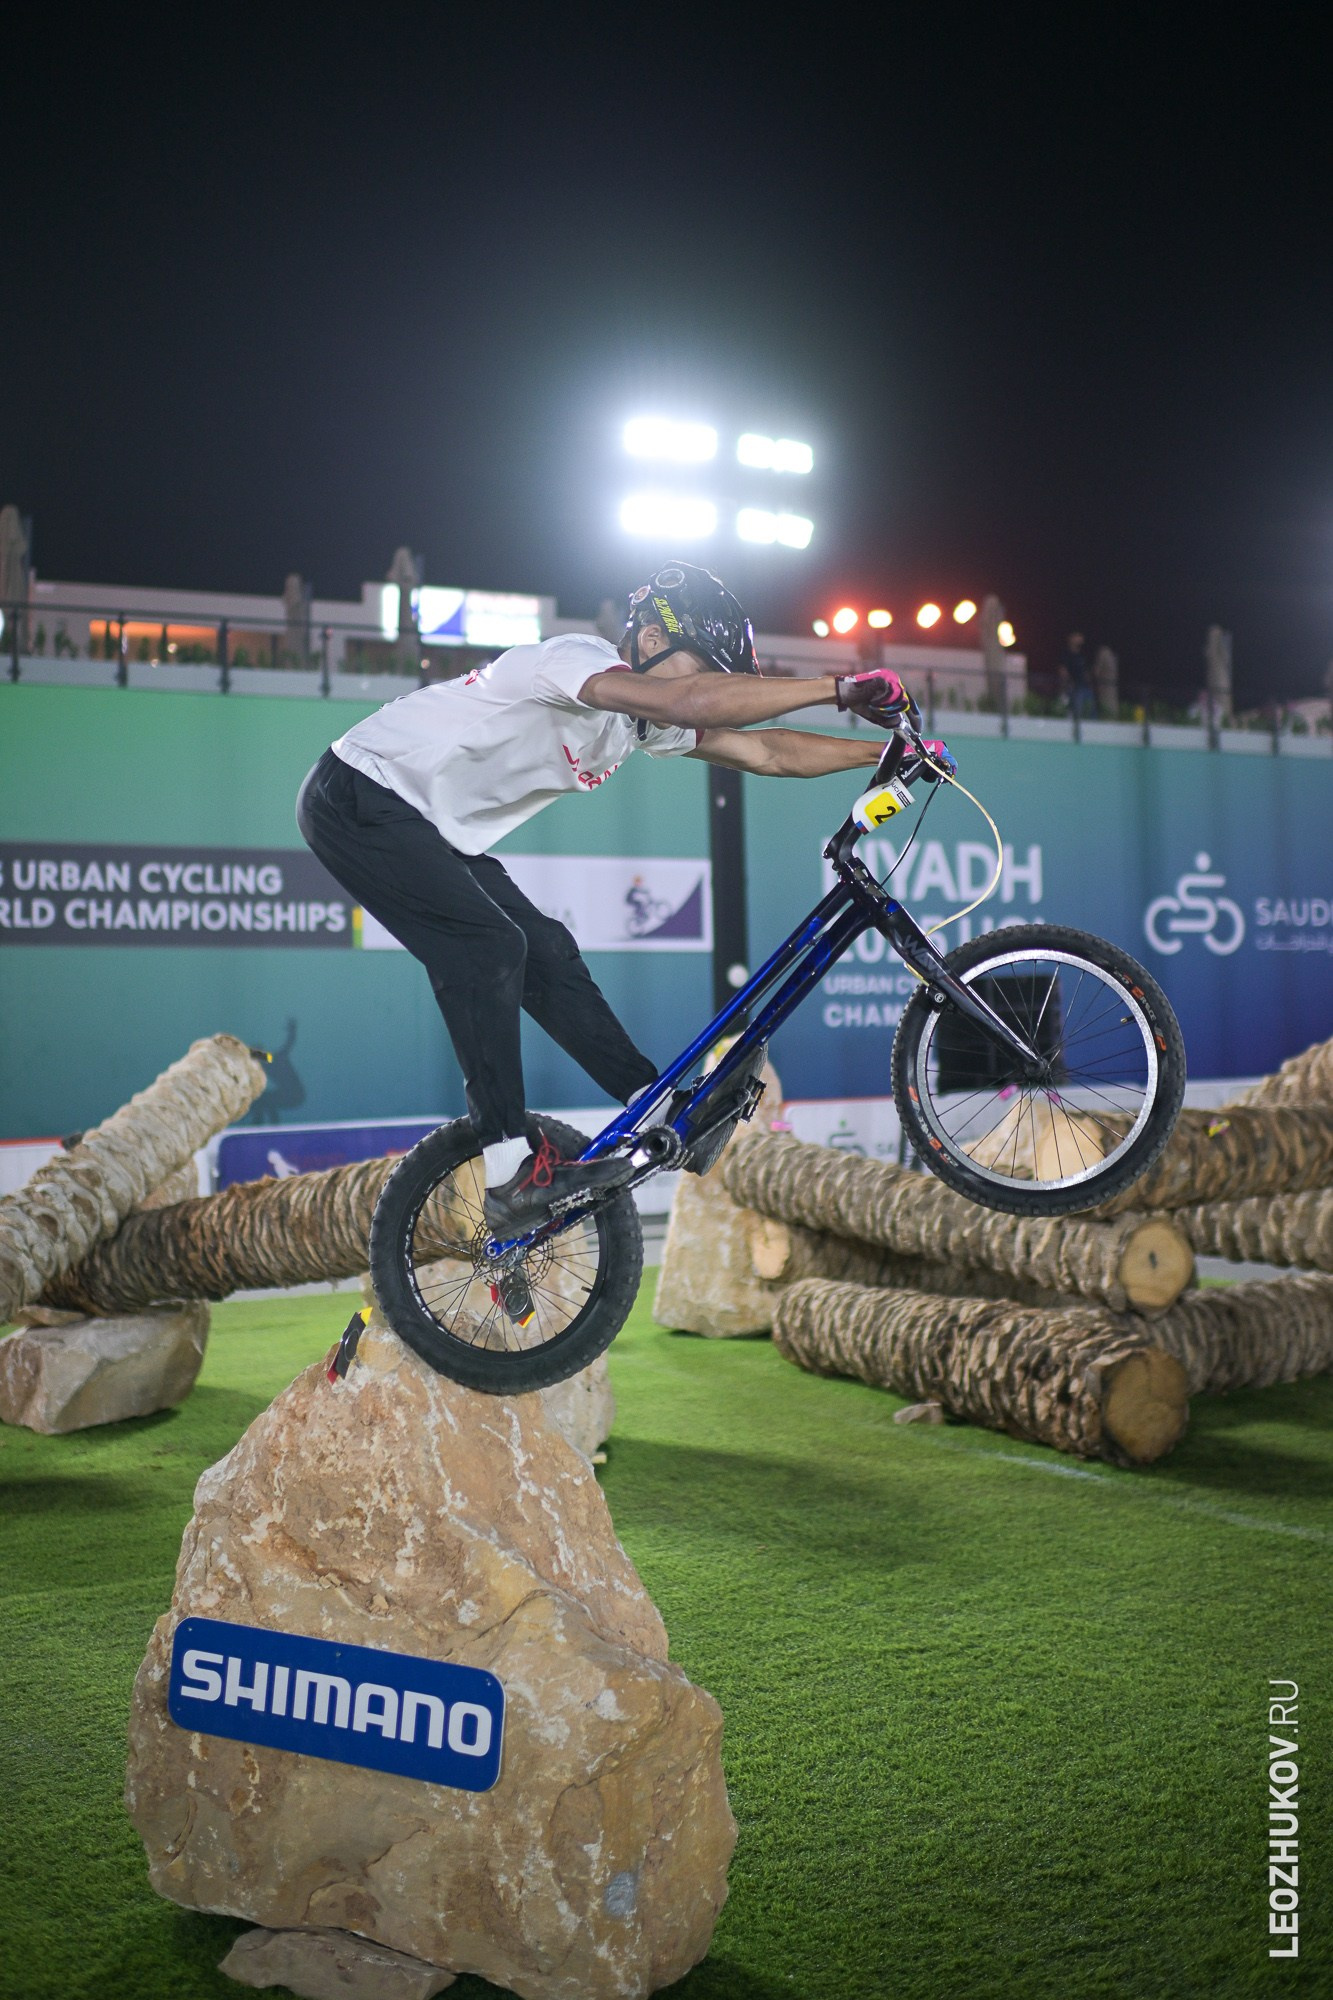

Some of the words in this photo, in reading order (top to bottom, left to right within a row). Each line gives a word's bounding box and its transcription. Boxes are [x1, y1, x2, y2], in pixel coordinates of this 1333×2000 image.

[874, 805, 897, 825] 2
[13, 860, 130, 893] URBAN
[139, 862, 283, 895] CYCLING
[64, 898, 347, 933] CHAMPIONSHIPS
[824, 975, 893, 995] URBAN
[180, 1649, 493, 1757] SHIMANO
